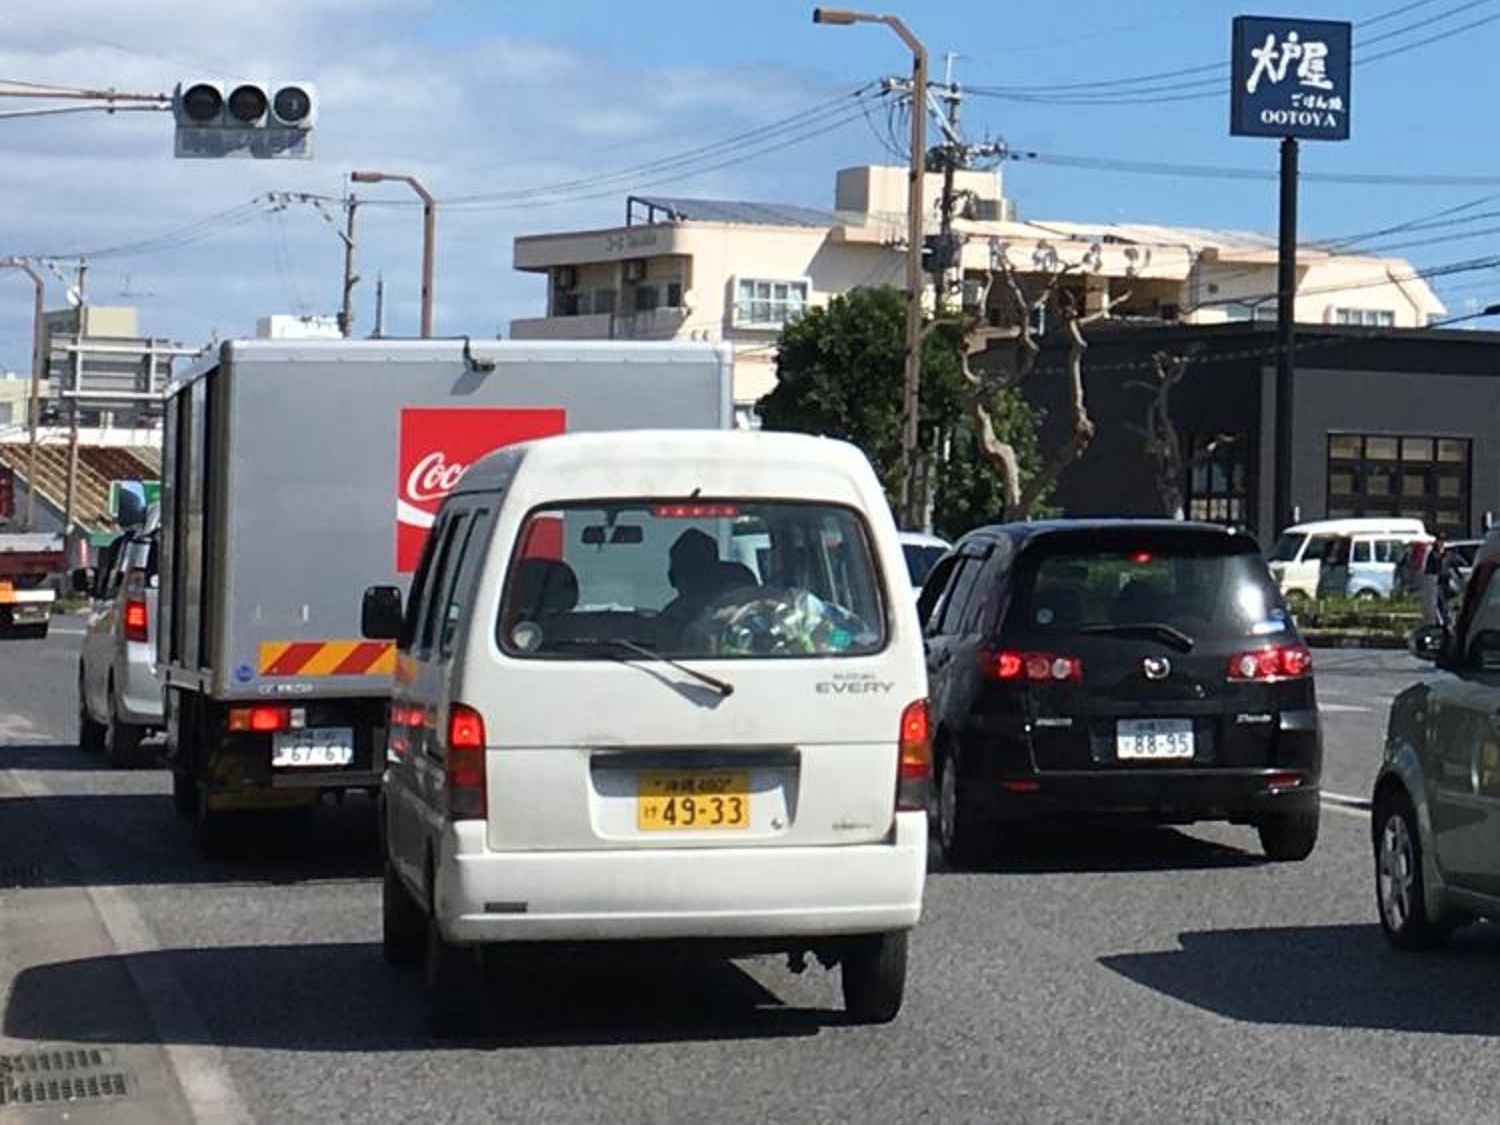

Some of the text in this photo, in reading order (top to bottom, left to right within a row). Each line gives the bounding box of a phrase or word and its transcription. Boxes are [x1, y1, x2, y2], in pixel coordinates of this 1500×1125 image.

[1246, 31, 1334, 94] 大戸屋
[1261, 110, 1337, 127] OOTOYA
[407, 452, 471, 501] Coc
[816, 682, 896, 694] EVERY
[1135, 733, 1189, 754] 88-95
[663, 797, 743, 825] 49-33
